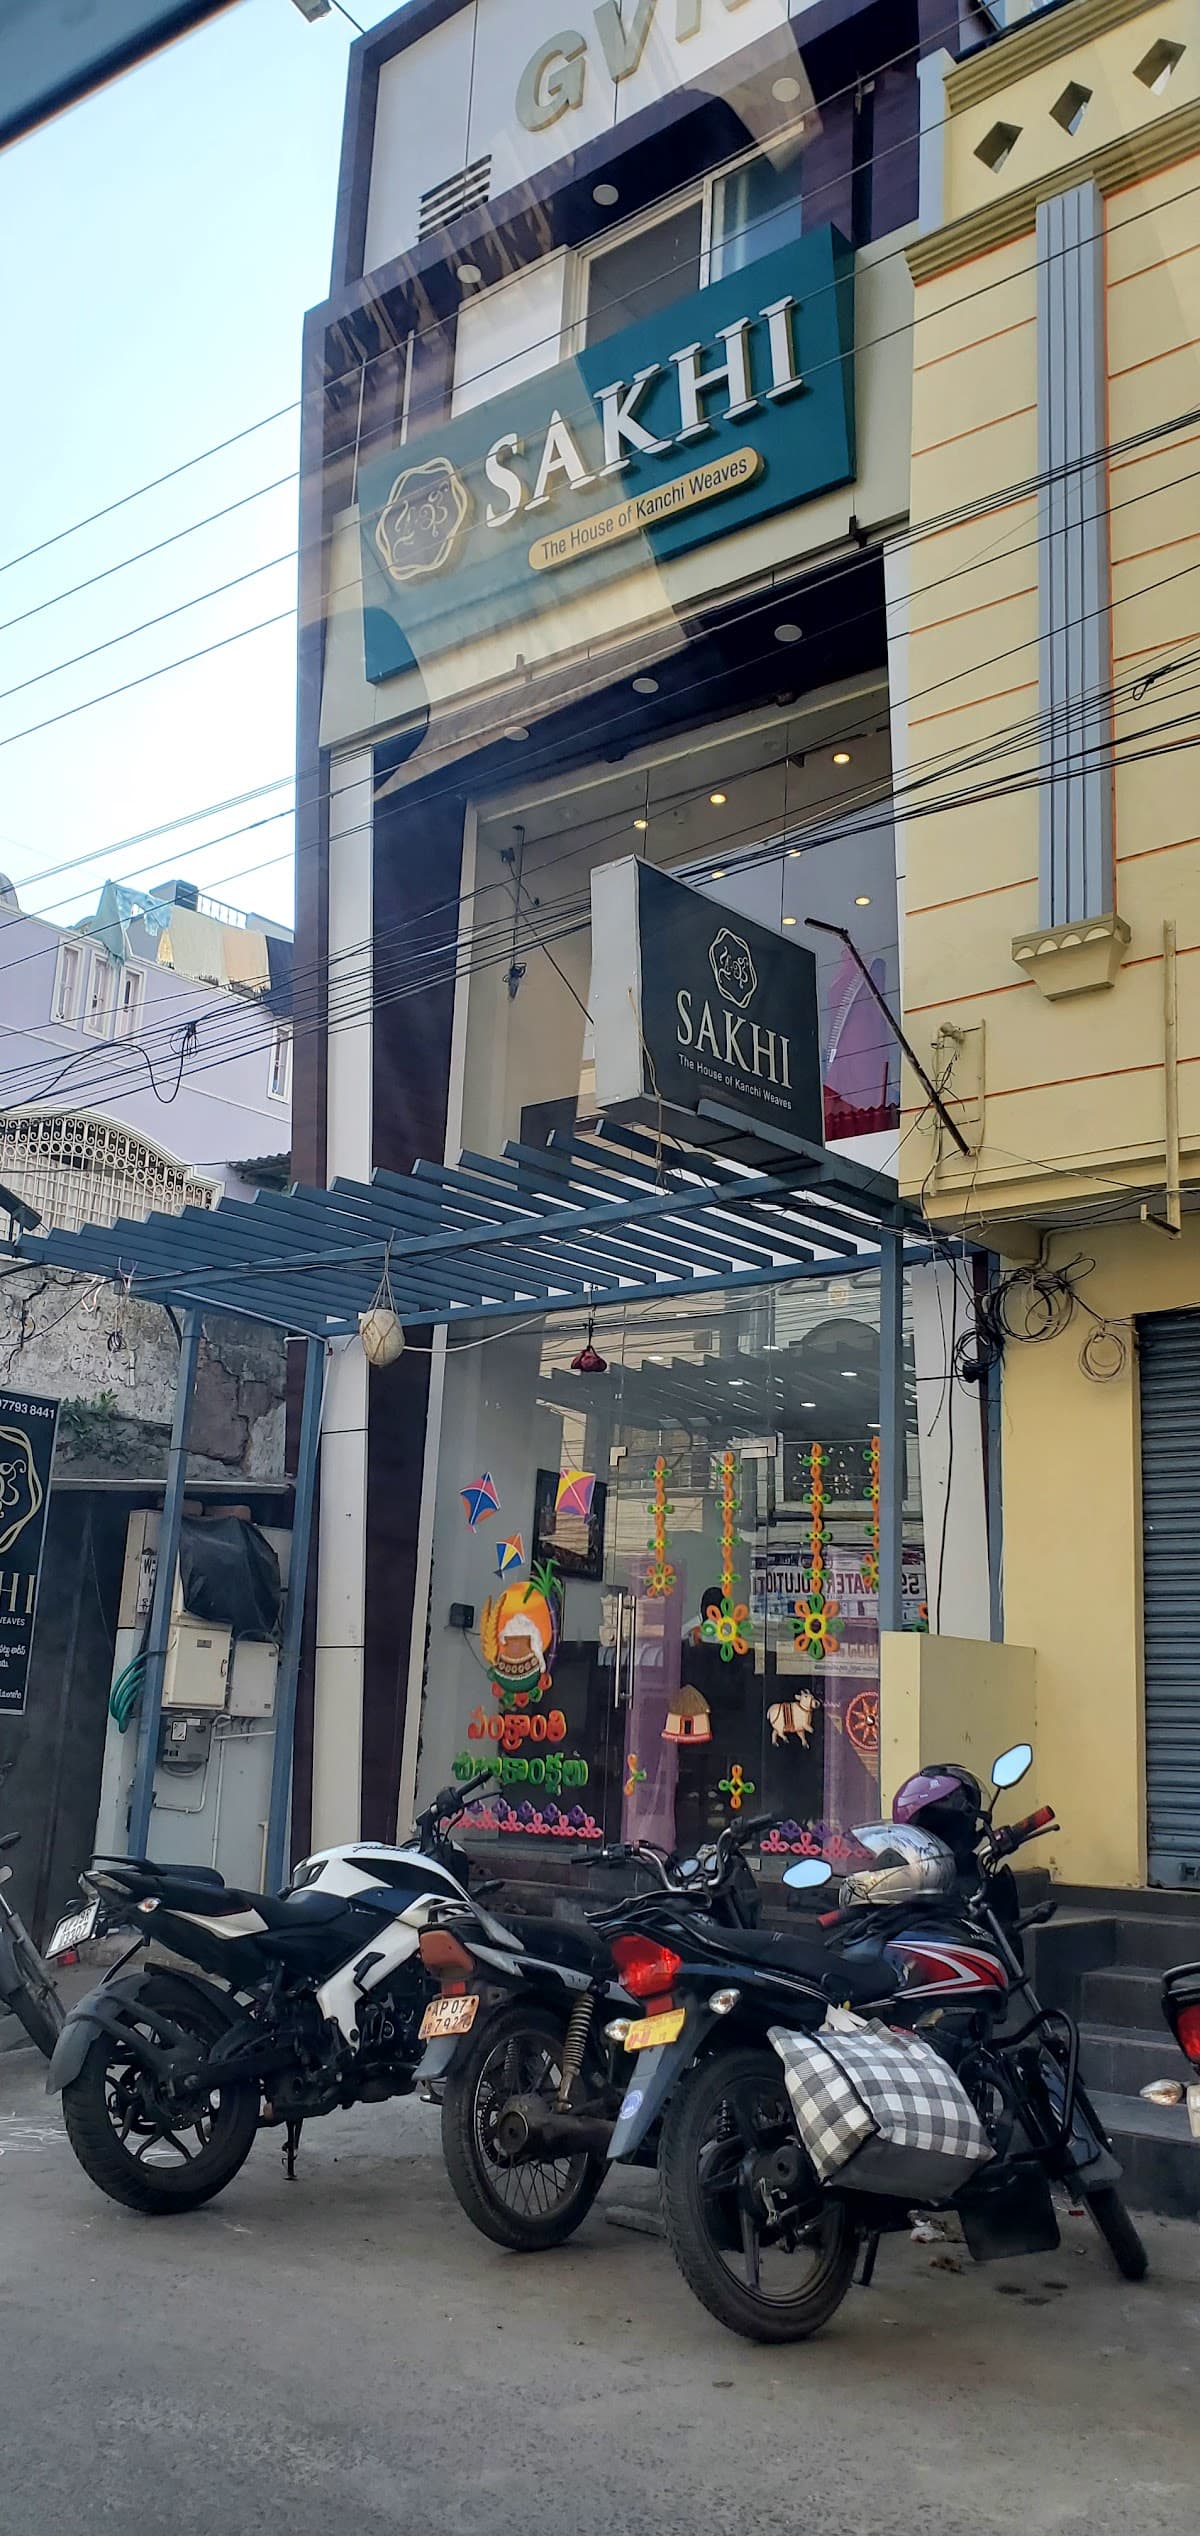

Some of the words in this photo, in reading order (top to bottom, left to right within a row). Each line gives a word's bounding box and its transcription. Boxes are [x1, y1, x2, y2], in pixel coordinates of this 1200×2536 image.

[515, 0, 752, 132] GV
[485, 296, 803, 528] SAKHI
[542, 539, 567, 561] The
[570, 518, 614, 549] House
[618, 506, 633, 528] of
[636, 483, 686, 520] Kanchi
[689, 458, 748, 496] Weaves
[676, 990, 793, 1090] SAKHI
[679, 1053, 694, 1070] The
[697, 1061, 723, 1082] House
[725, 1075, 733, 1087] of
[735, 1079, 761, 1097] Kanchi
[763, 1088, 792, 1110] Weaves
[29, 1404, 55, 1420] 8441
[451, 1999, 468, 2014] 07
